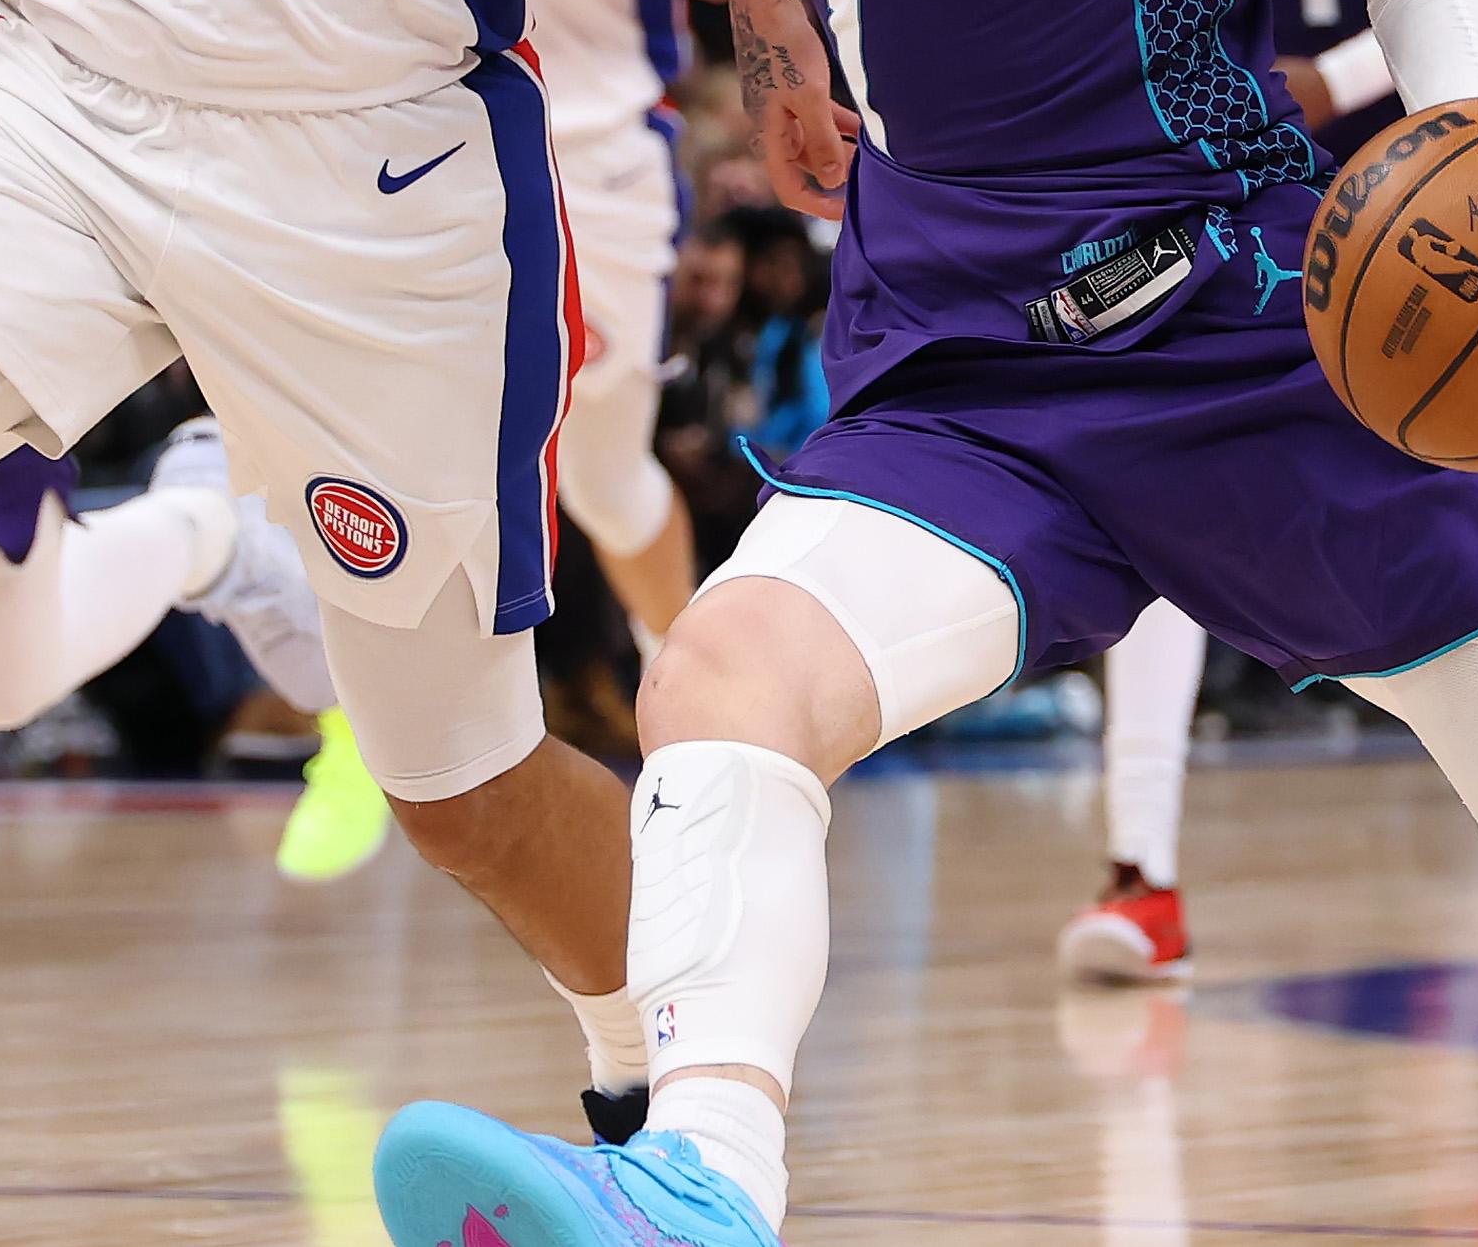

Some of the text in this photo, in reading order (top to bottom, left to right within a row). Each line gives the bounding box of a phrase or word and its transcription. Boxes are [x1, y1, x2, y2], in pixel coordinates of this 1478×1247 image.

[1305, 110, 1478, 313] Wilson
[322, 496, 385, 540] DETROIT
[322, 511, 384, 555] PISTONS
